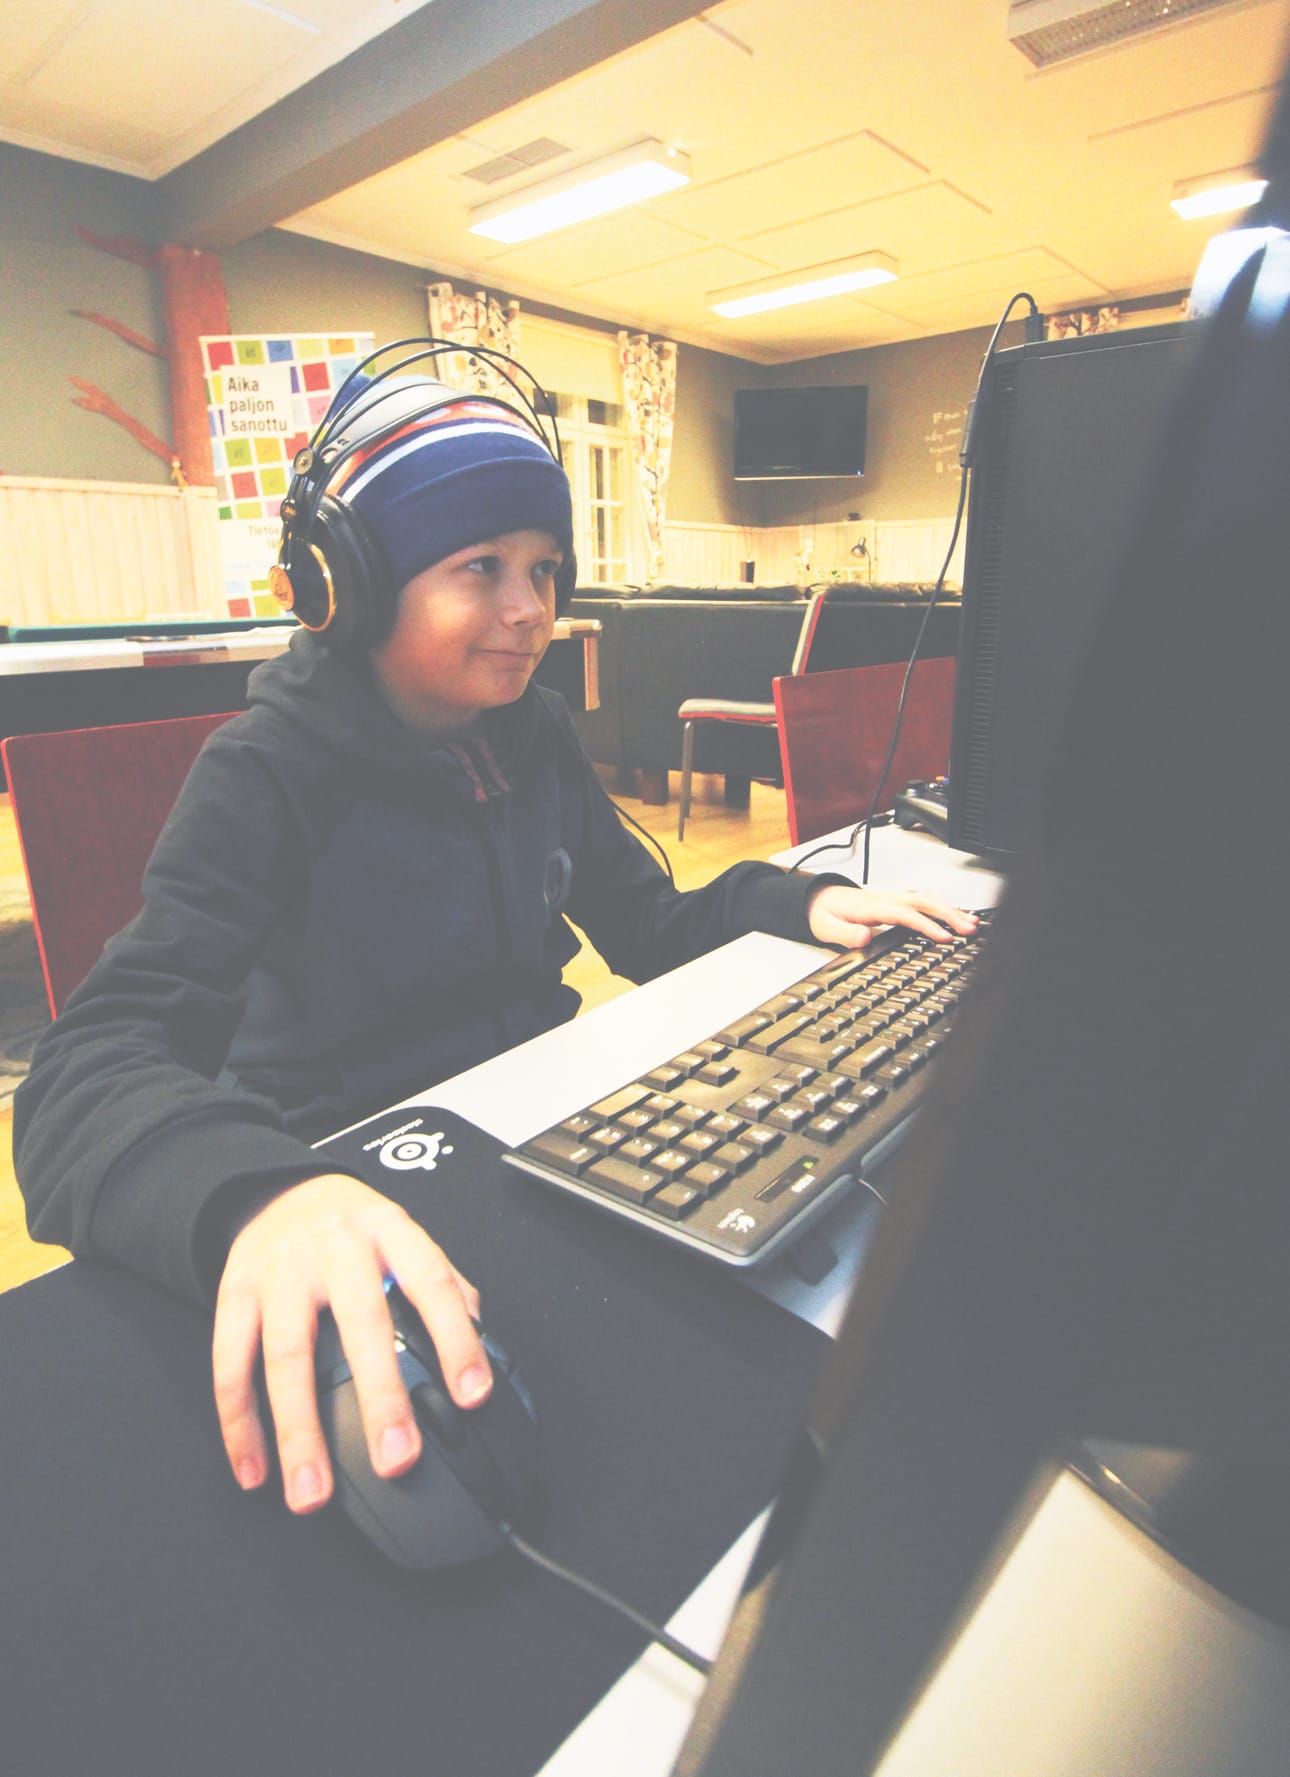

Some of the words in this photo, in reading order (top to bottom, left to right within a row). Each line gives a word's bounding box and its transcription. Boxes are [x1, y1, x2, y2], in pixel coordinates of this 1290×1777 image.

[228, 376, 259, 392] Aika
[230, 397, 274, 415] paljon
[231, 419, 288, 432] sanottu
[248, 526, 280, 536] Tietoa
